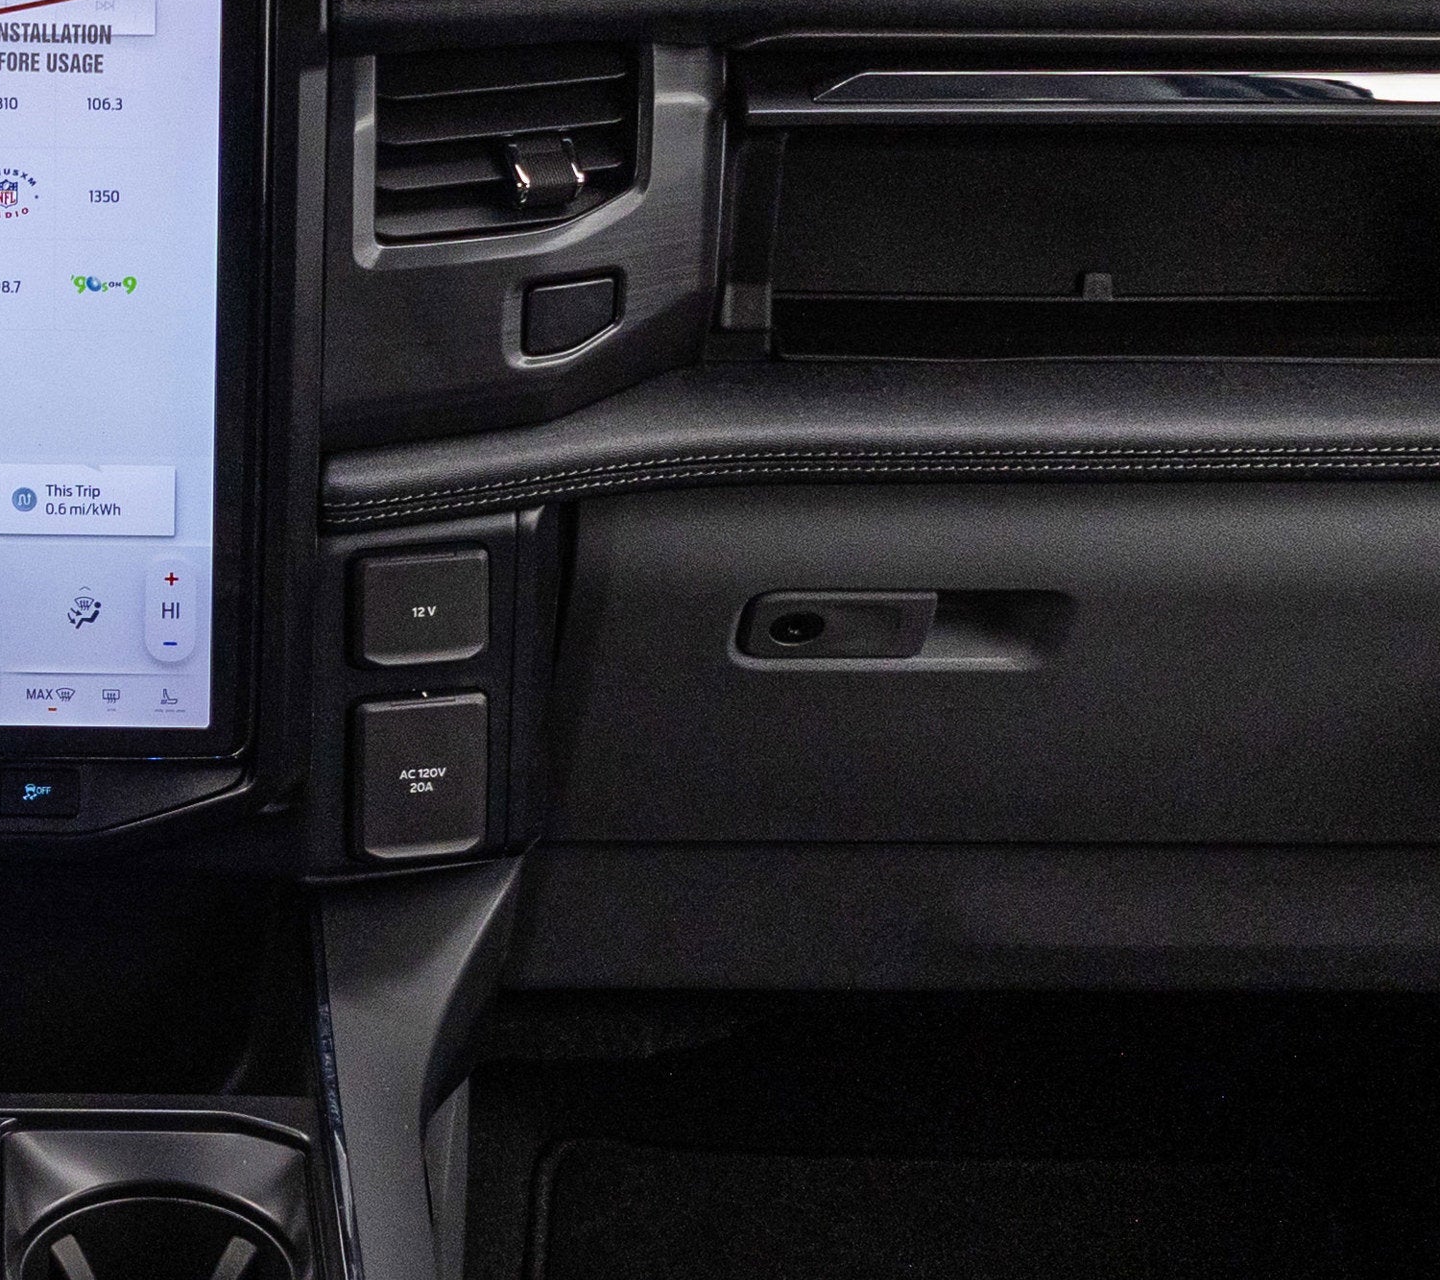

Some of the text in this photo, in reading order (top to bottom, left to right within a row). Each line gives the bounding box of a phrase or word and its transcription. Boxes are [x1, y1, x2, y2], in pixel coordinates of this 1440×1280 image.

[46, 53, 104, 74] USAGE
[86, 97, 123, 111] 106.3
[88, 190, 120, 203] 1350
[122, 275, 138, 295] 9
[45, 483, 101, 500] This Trip
[45, 502, 121, 517] 0.6 mi/kWh
[161, 602, 180, 620] HI
[411, 606, 437, 618] 12 V
[25, 688, 54, 701] MAX
[398, 766, 447, 780] AC 120V
[36, 786, 52, 795] OFF
[409, 781, 434, 794] 20A
